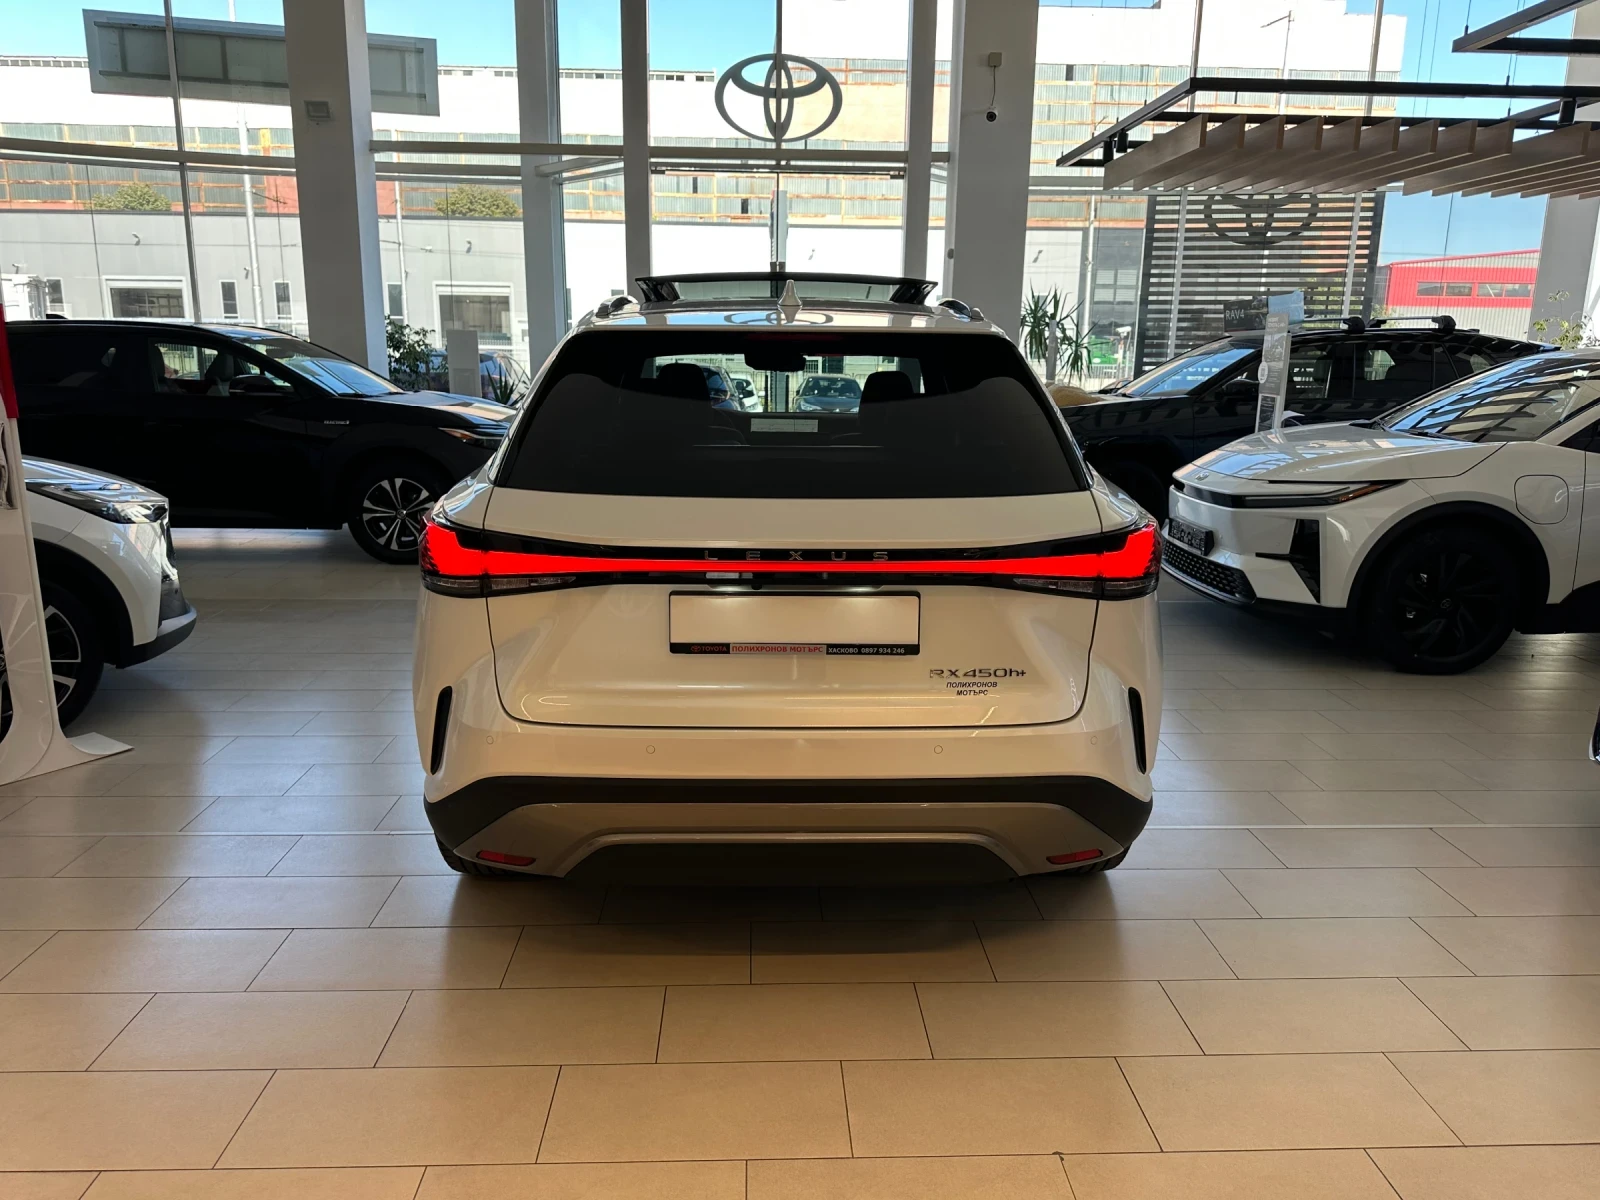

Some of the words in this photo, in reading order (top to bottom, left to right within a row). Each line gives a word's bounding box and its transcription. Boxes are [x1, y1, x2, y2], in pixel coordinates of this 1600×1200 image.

[1225, 309, 1245, 320] RAV4
[704, 550, 889, 561] LEXUS
[731, 645, 788, 653] ПОЛИХРОНОВ
[789, 645, 823, 653] МОТЪРС
[946, 681, 998, 689] ПОЛИХРОНОВ
